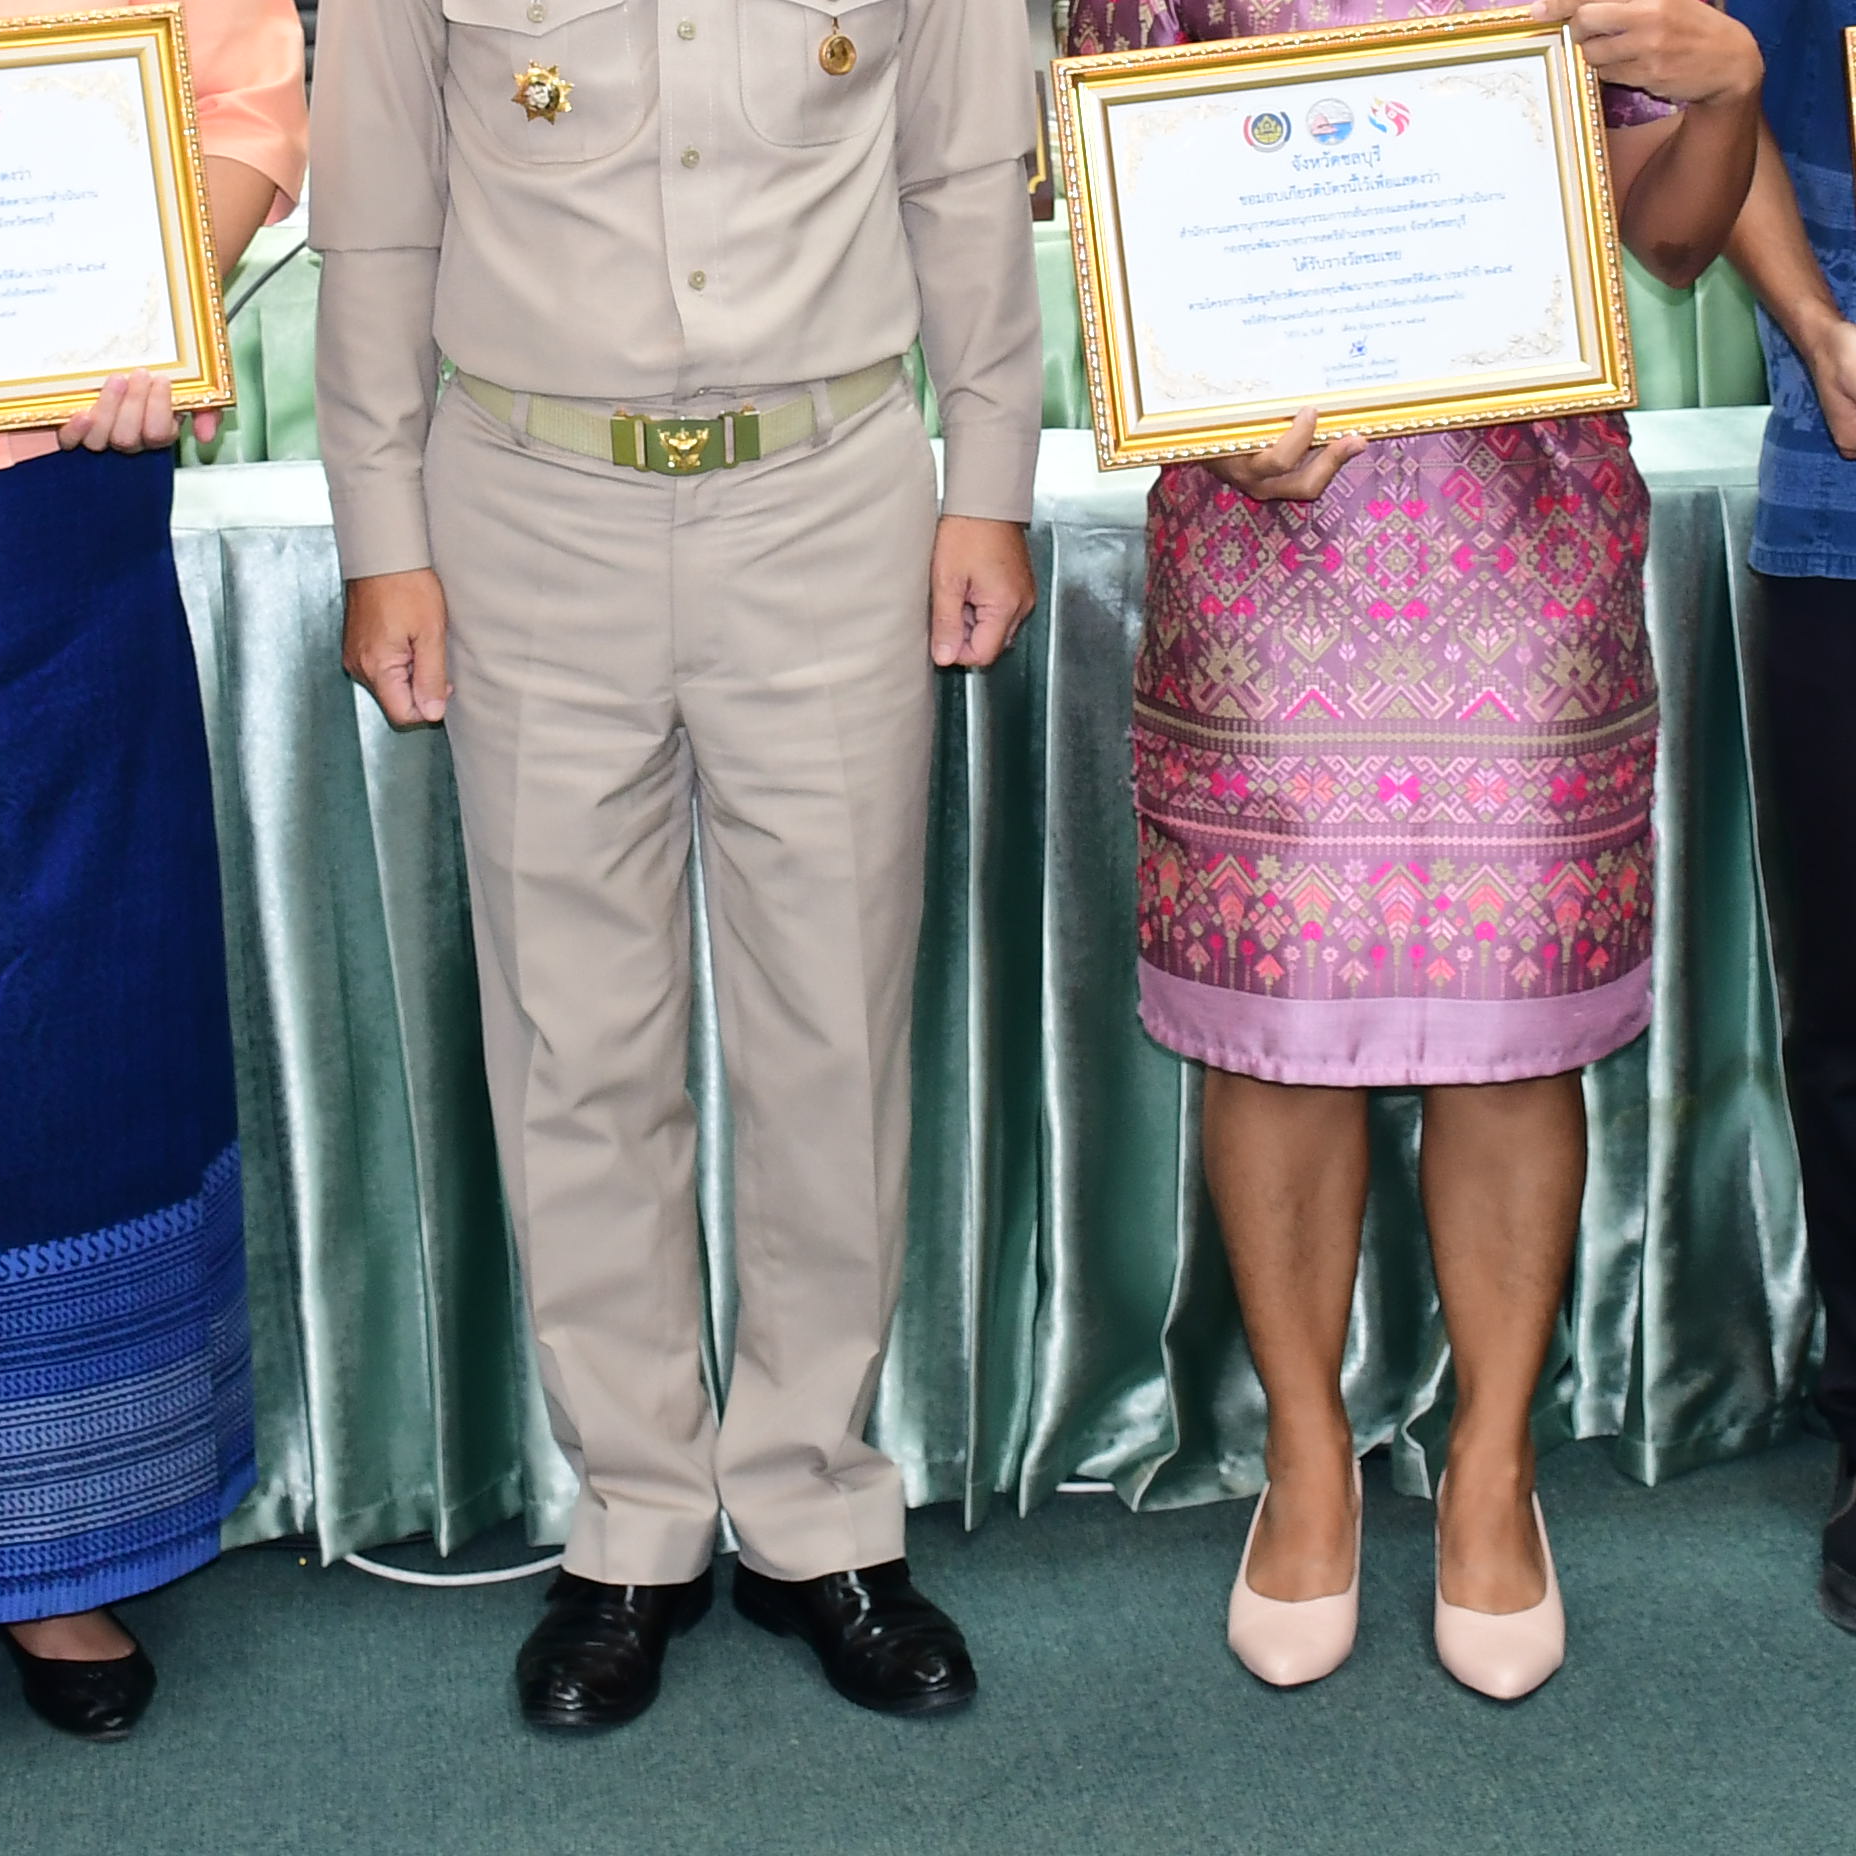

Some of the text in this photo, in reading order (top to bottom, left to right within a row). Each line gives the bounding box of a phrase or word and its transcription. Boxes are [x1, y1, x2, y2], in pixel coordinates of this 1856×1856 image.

[1291, 144, 1381, 172] จังหวัดชลบุรี
[1239, 172, 1440, 206] ขอมอบเกียรติบัตรนี้ไว้เพื่อแสดงว่า
[1292, 250, 1402, 272] ได้รับรางวัลชมเชย
